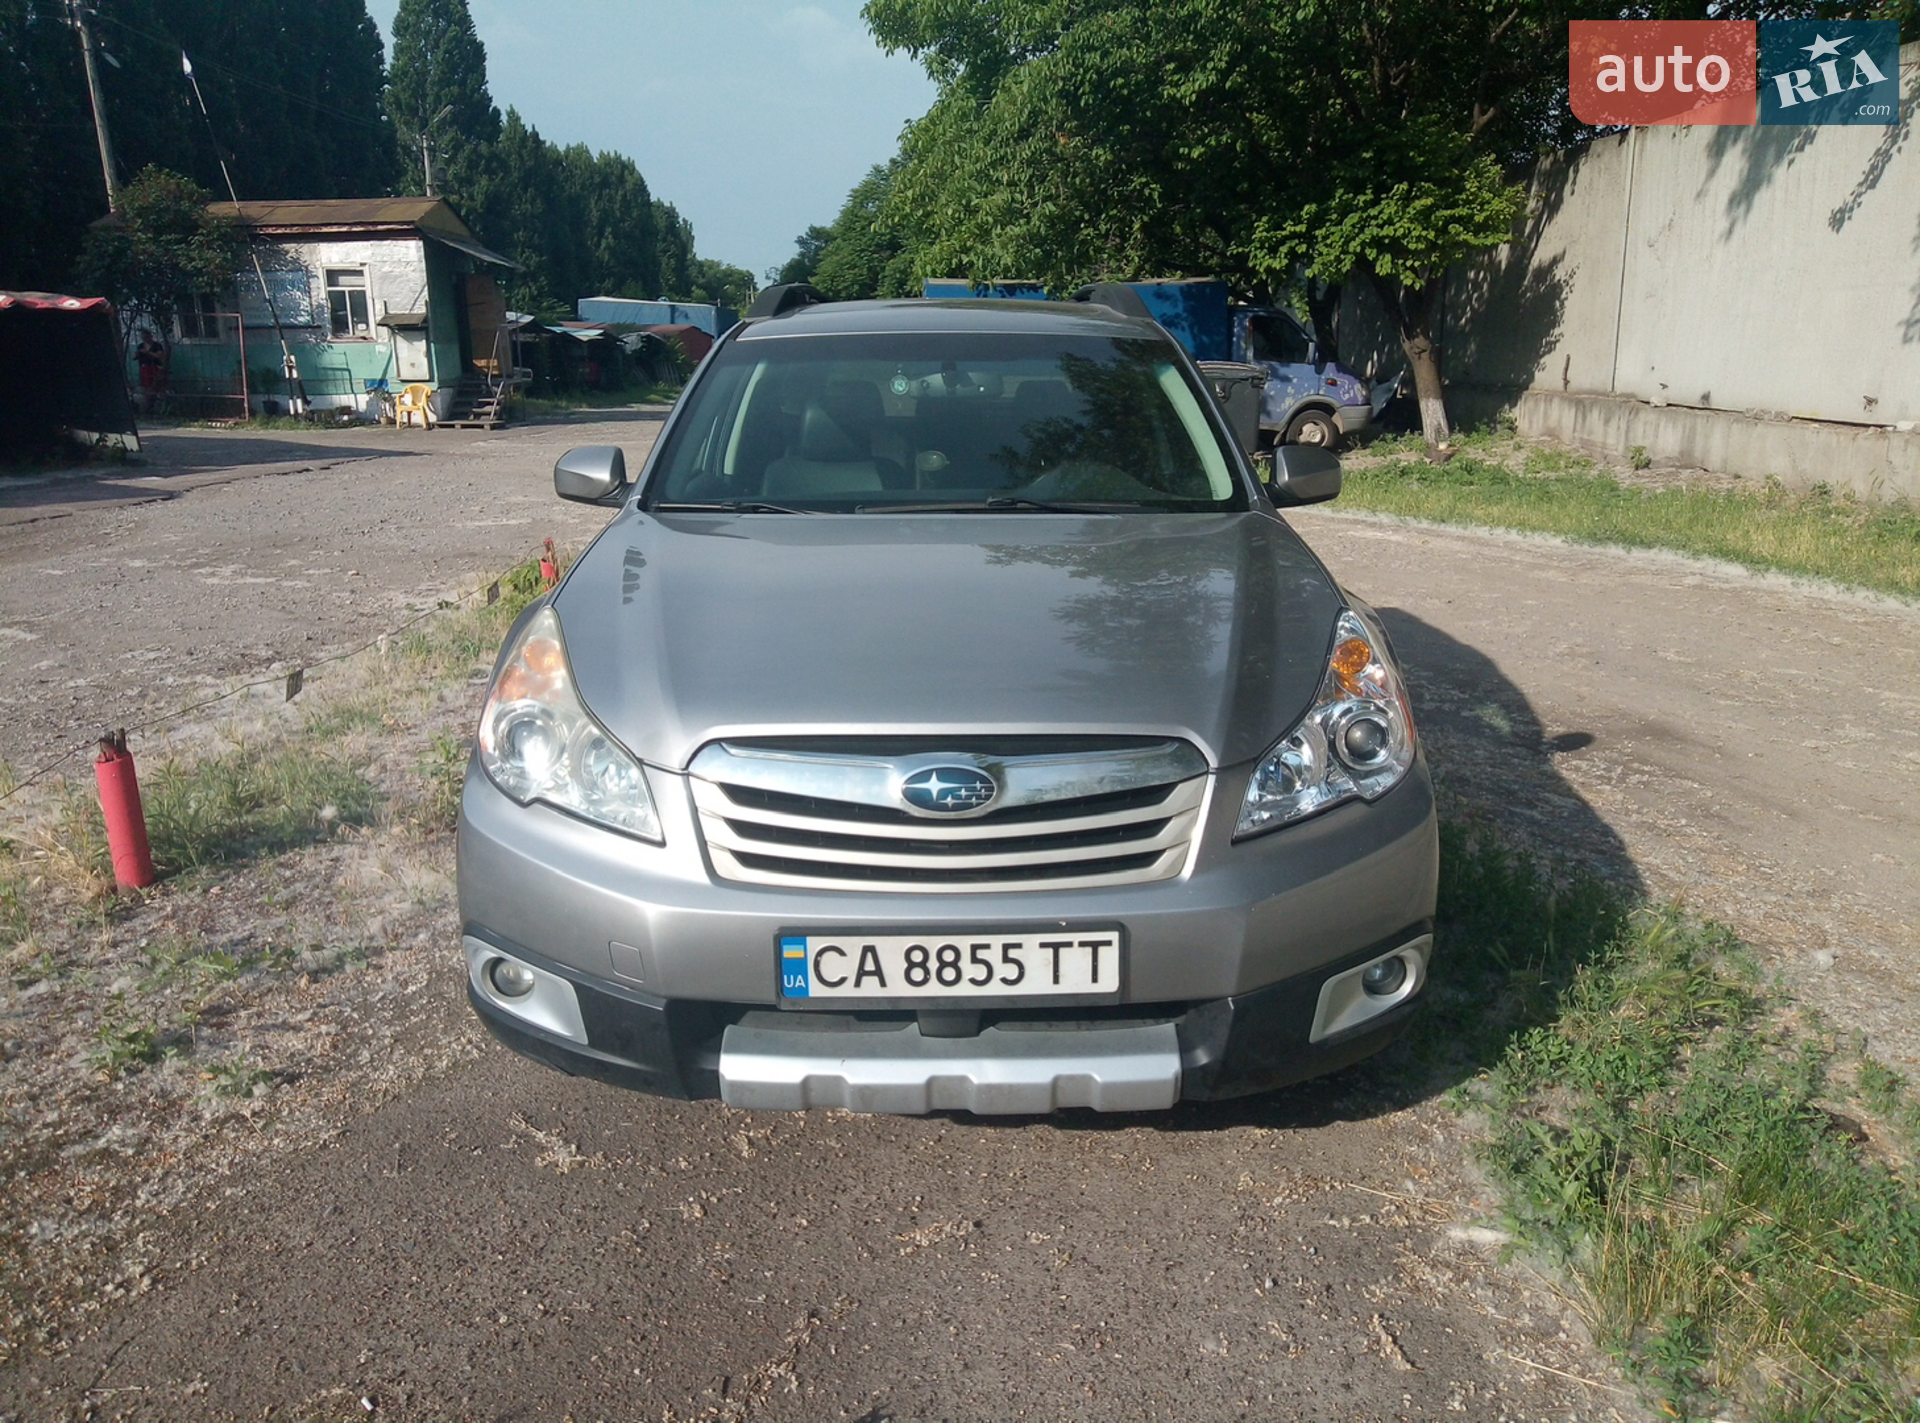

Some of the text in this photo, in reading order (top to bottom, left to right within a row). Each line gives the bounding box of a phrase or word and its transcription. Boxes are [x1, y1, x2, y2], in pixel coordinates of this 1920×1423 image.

[813, 940, 1113, 988] CA 8855 TT
[783, 975, 806, 989] UA
